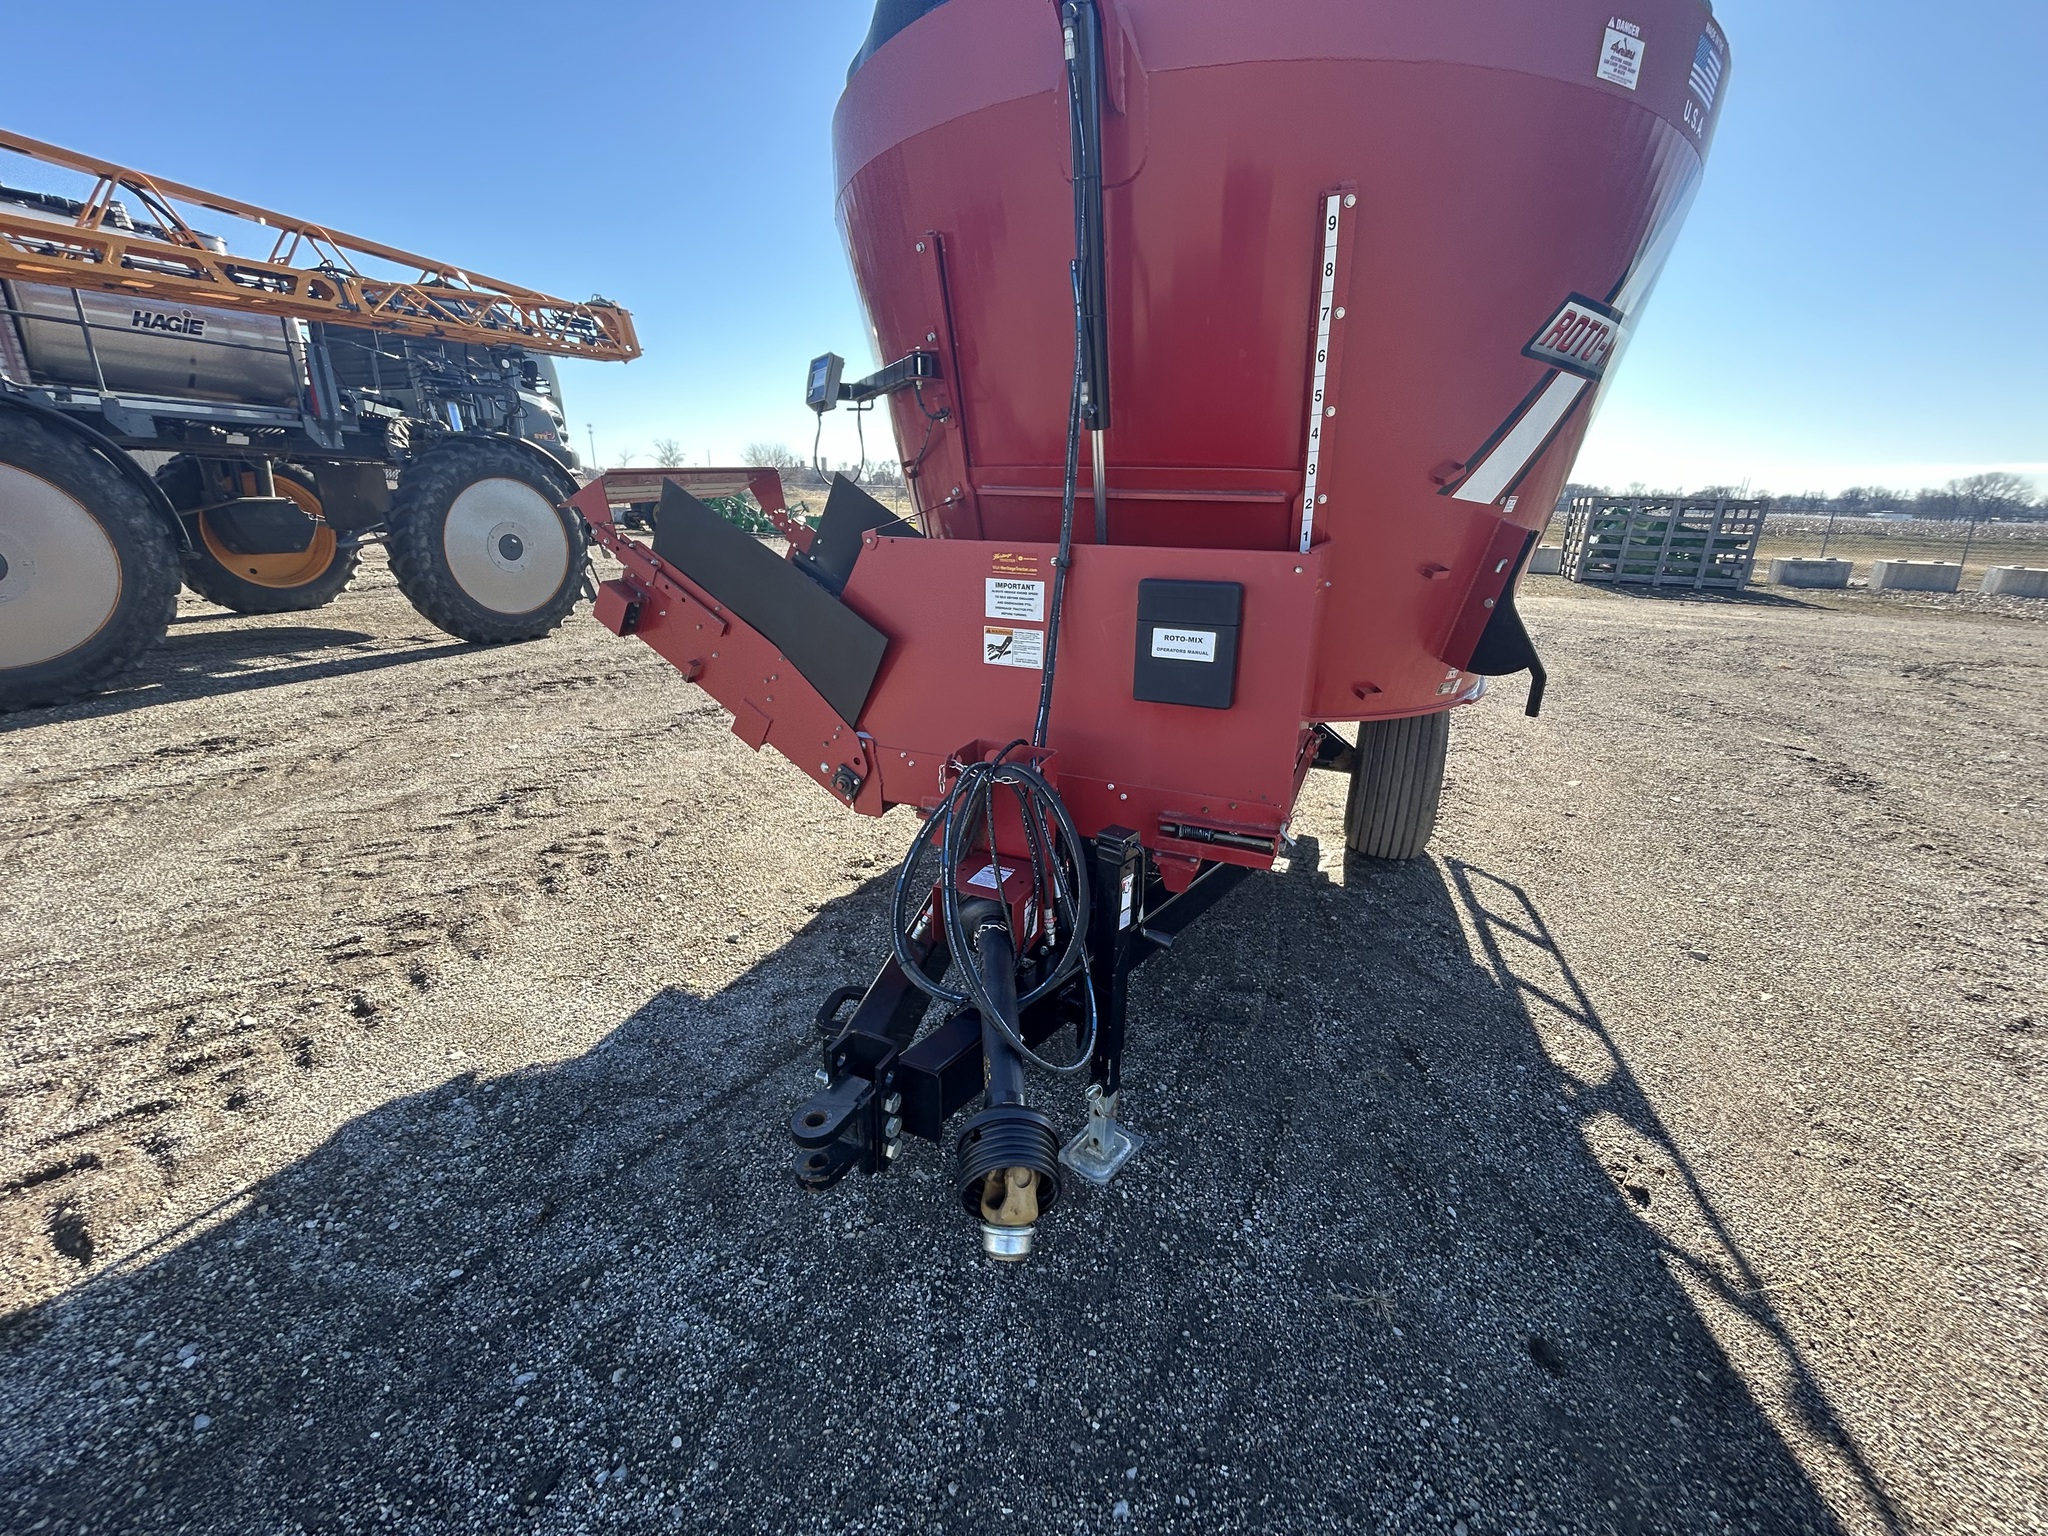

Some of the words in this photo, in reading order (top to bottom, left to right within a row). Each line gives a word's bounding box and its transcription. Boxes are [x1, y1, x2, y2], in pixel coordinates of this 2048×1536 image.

[1615, 18, 1640, 38] DANGER
[1328, 215, 1337, 231] 9
[1325, 262, 1333, 277] 8
[1321, 307, 1330, 321] 7
[131, 309, 205, 336] HAGIE
[1318, 349, 1326, 363] 6
[1314, 389, 1323, 402] 5
[1311, 427, 1319, 439] 4
[1308, 463, 1316, 475] 3
[1305, 498, 1313, 510] 2
[1303, 531, 1309, 542] 1
[995, 582, 1035, 591] IMPORTANT
[1164, 634, 1204, 644] ROTO-MIX
